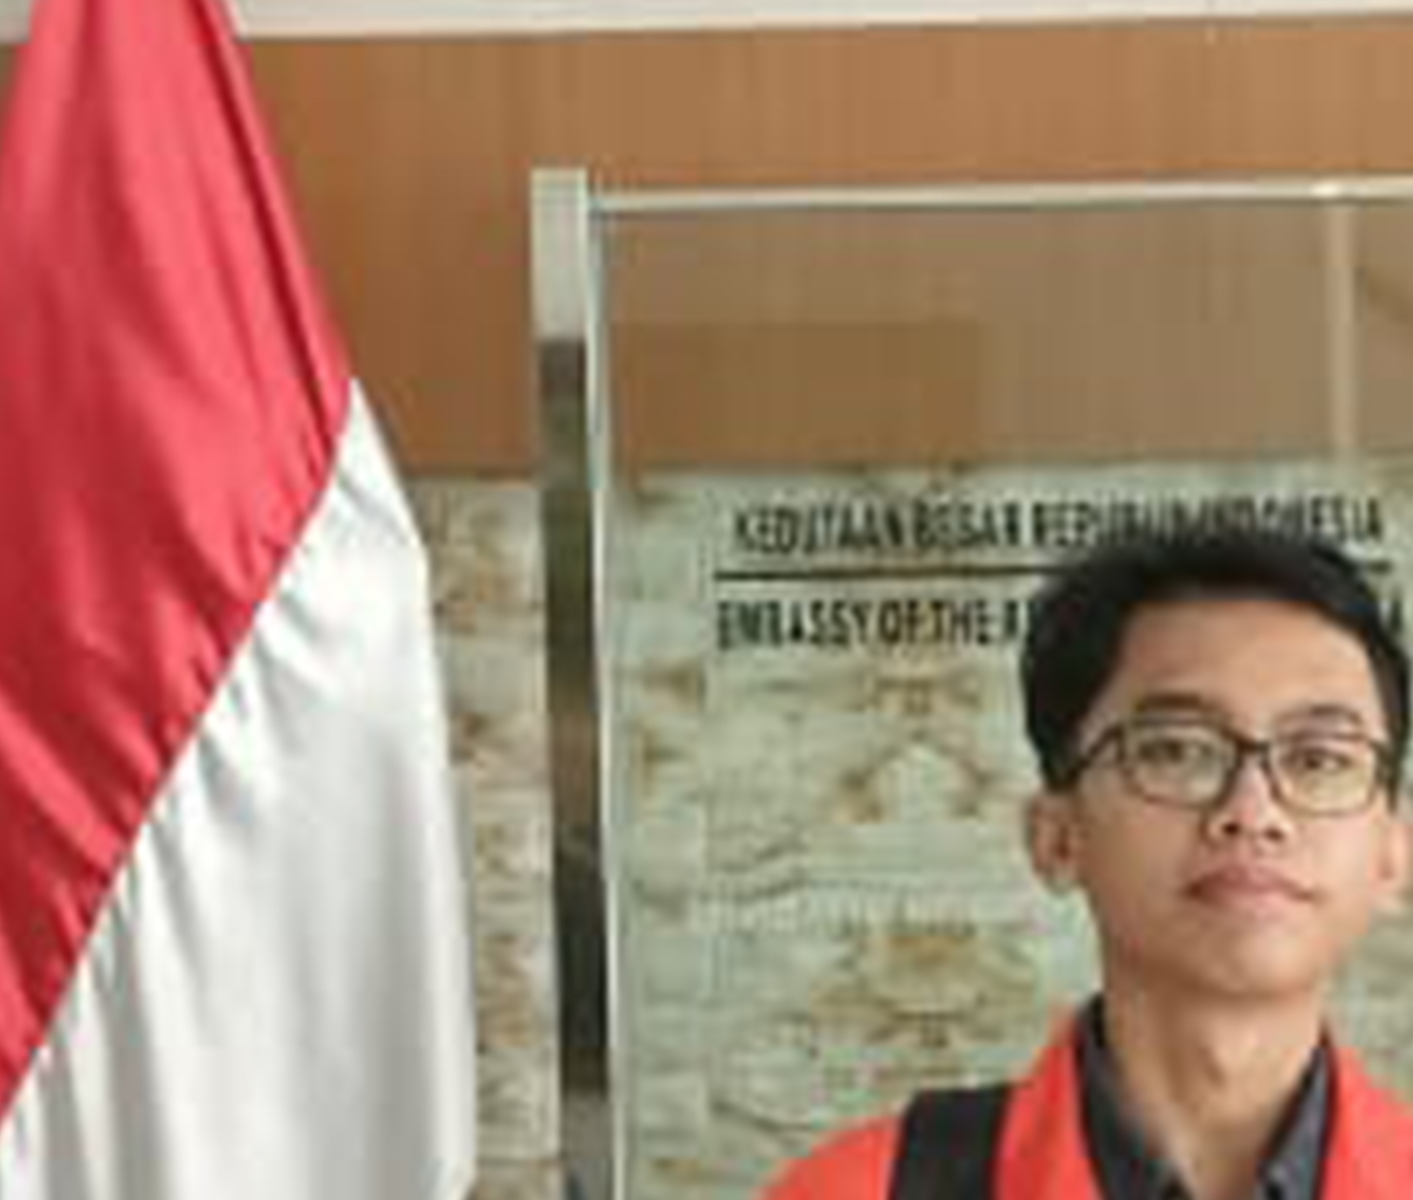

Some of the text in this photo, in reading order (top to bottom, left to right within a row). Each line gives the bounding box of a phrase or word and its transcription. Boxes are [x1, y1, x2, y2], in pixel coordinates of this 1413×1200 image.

[735, 504, 904, 556] KEDUTAAN
[912, 497, 1022, 552] BESAR
[717, 600, 873, 651] EMBASSY
[876, 599, 922, 647] OF
[927, 598, 992, 646] THE
